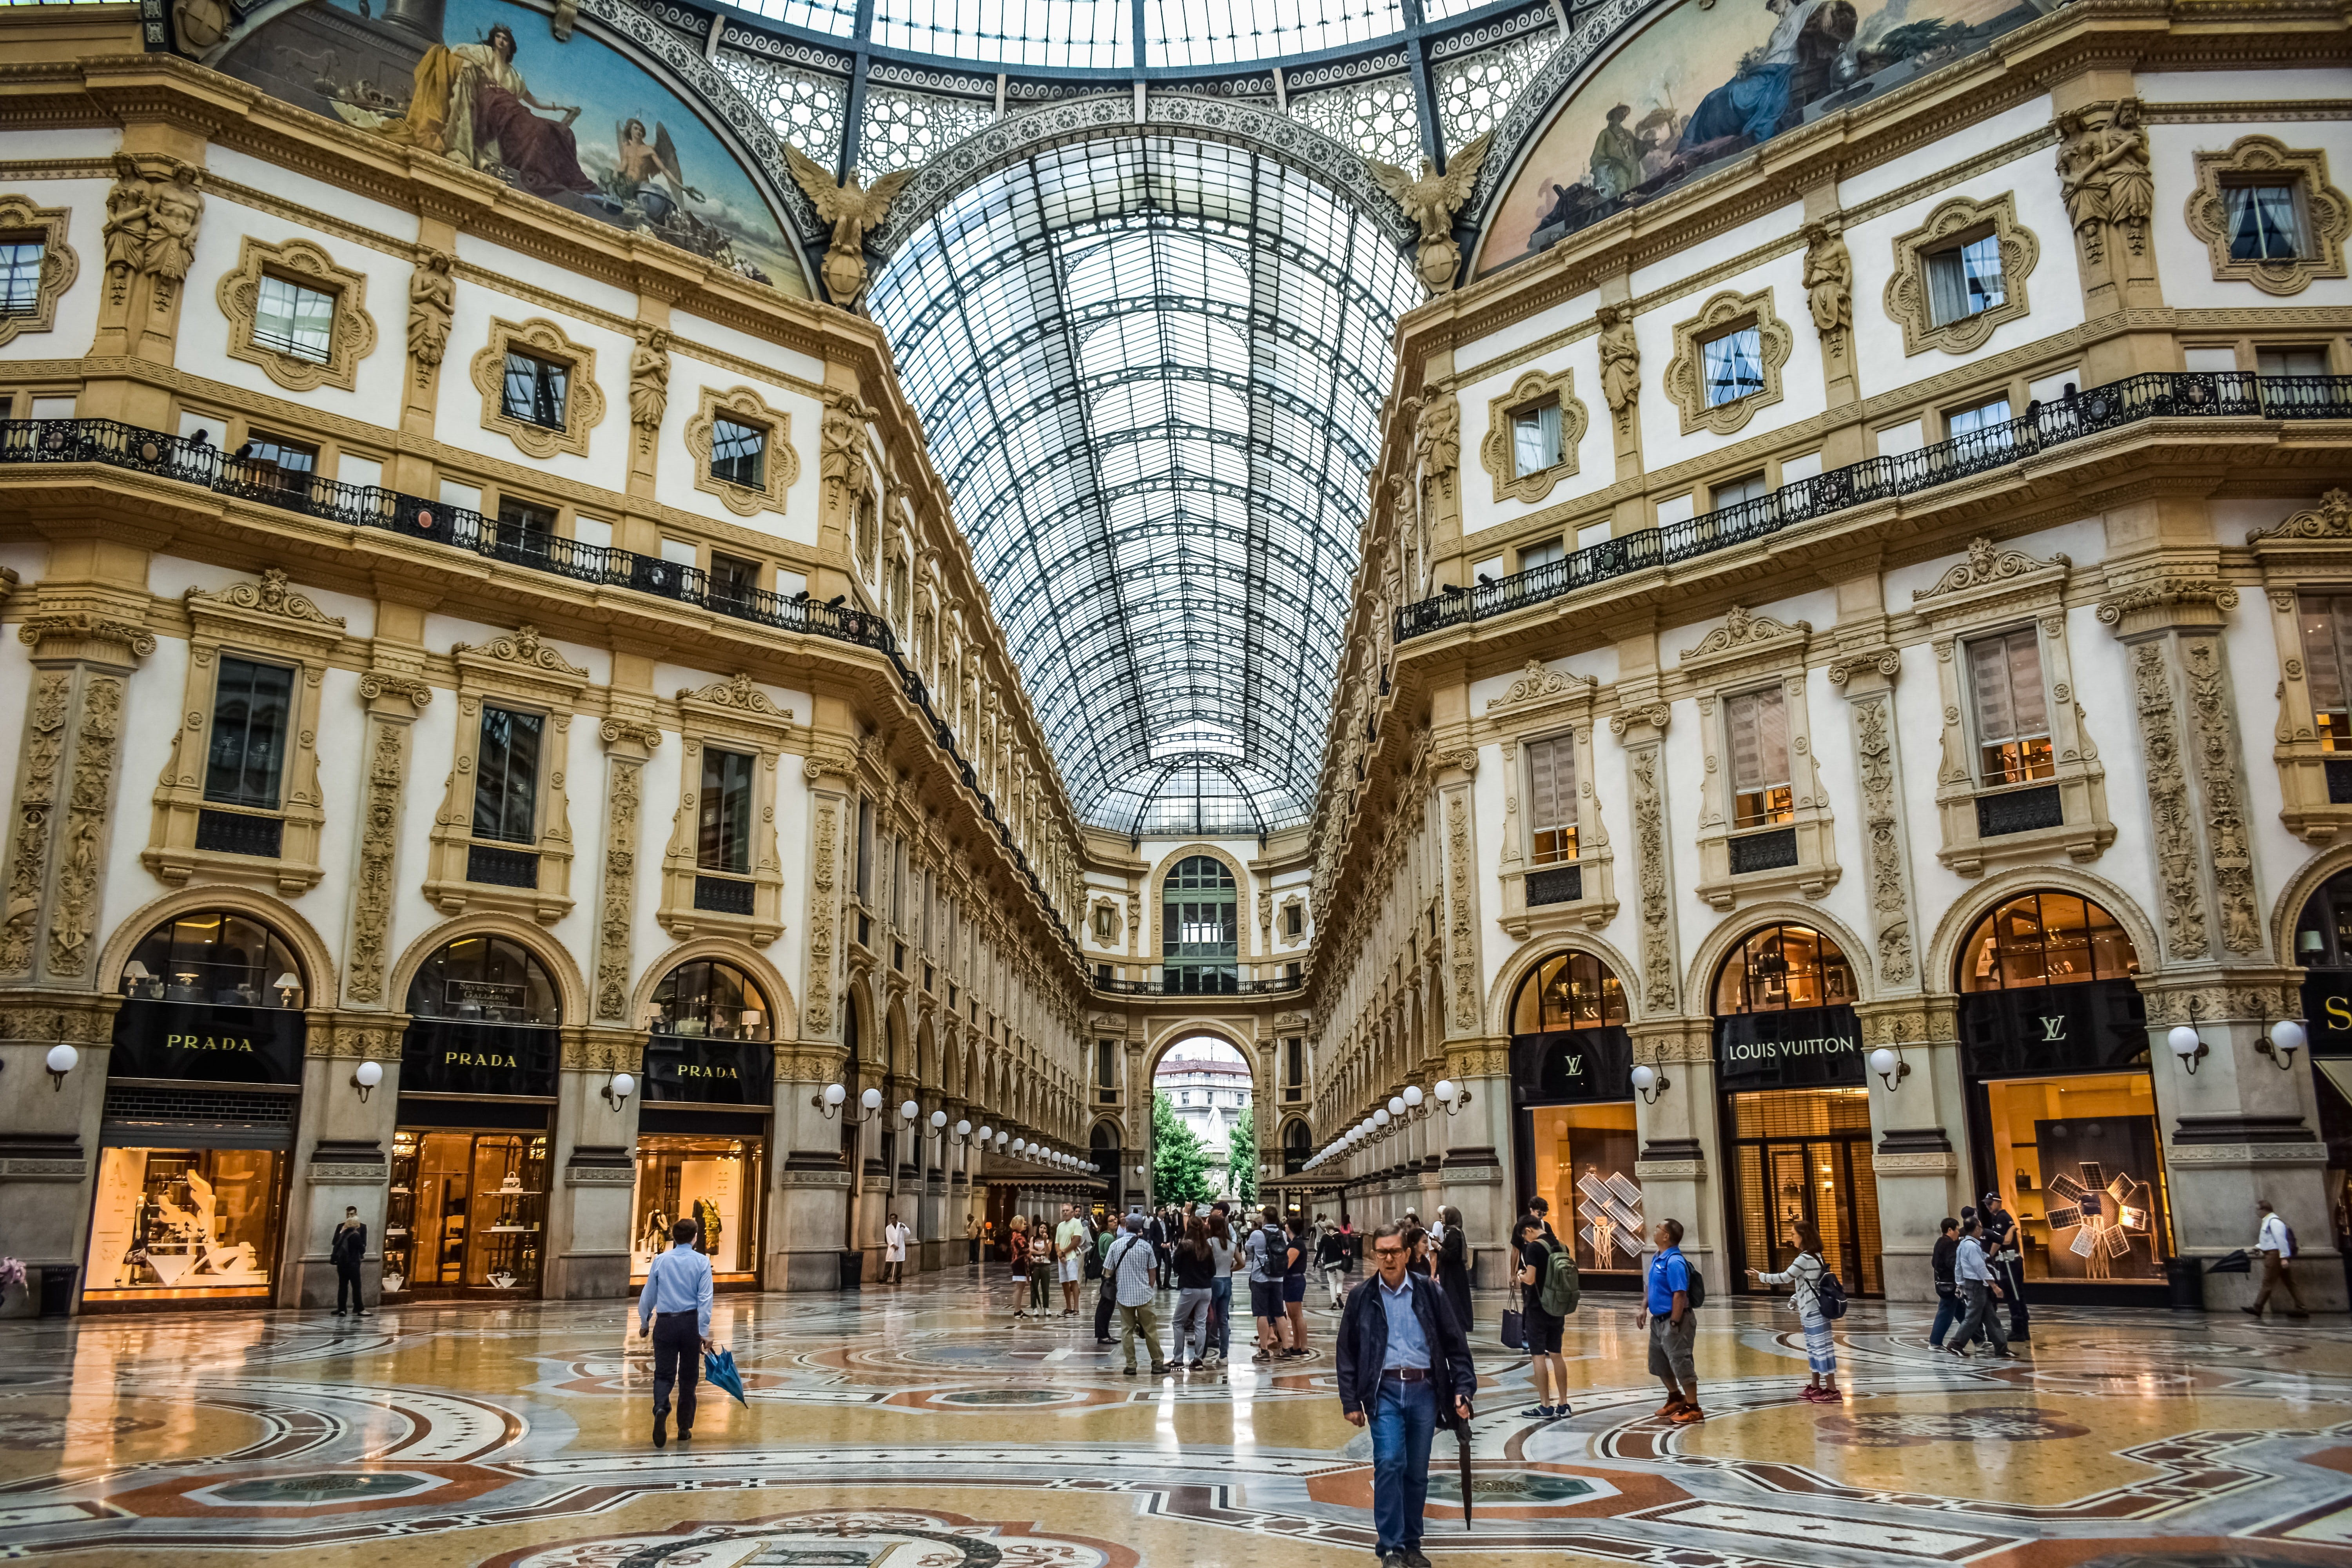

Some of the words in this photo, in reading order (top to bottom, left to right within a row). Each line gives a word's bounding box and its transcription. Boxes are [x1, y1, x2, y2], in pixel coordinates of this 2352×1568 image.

[464, 991, 508, 1001] GALLERIA
[167, 1034, 254, 1052] PRADA
[1729, 1042, 1776, 1060] LOUIS
[1779, 1036, 1855, 1056] VUITTON
[445, 1052, 517, 1067] PRADA
[677, 1064, 738, 1079] PRADA
